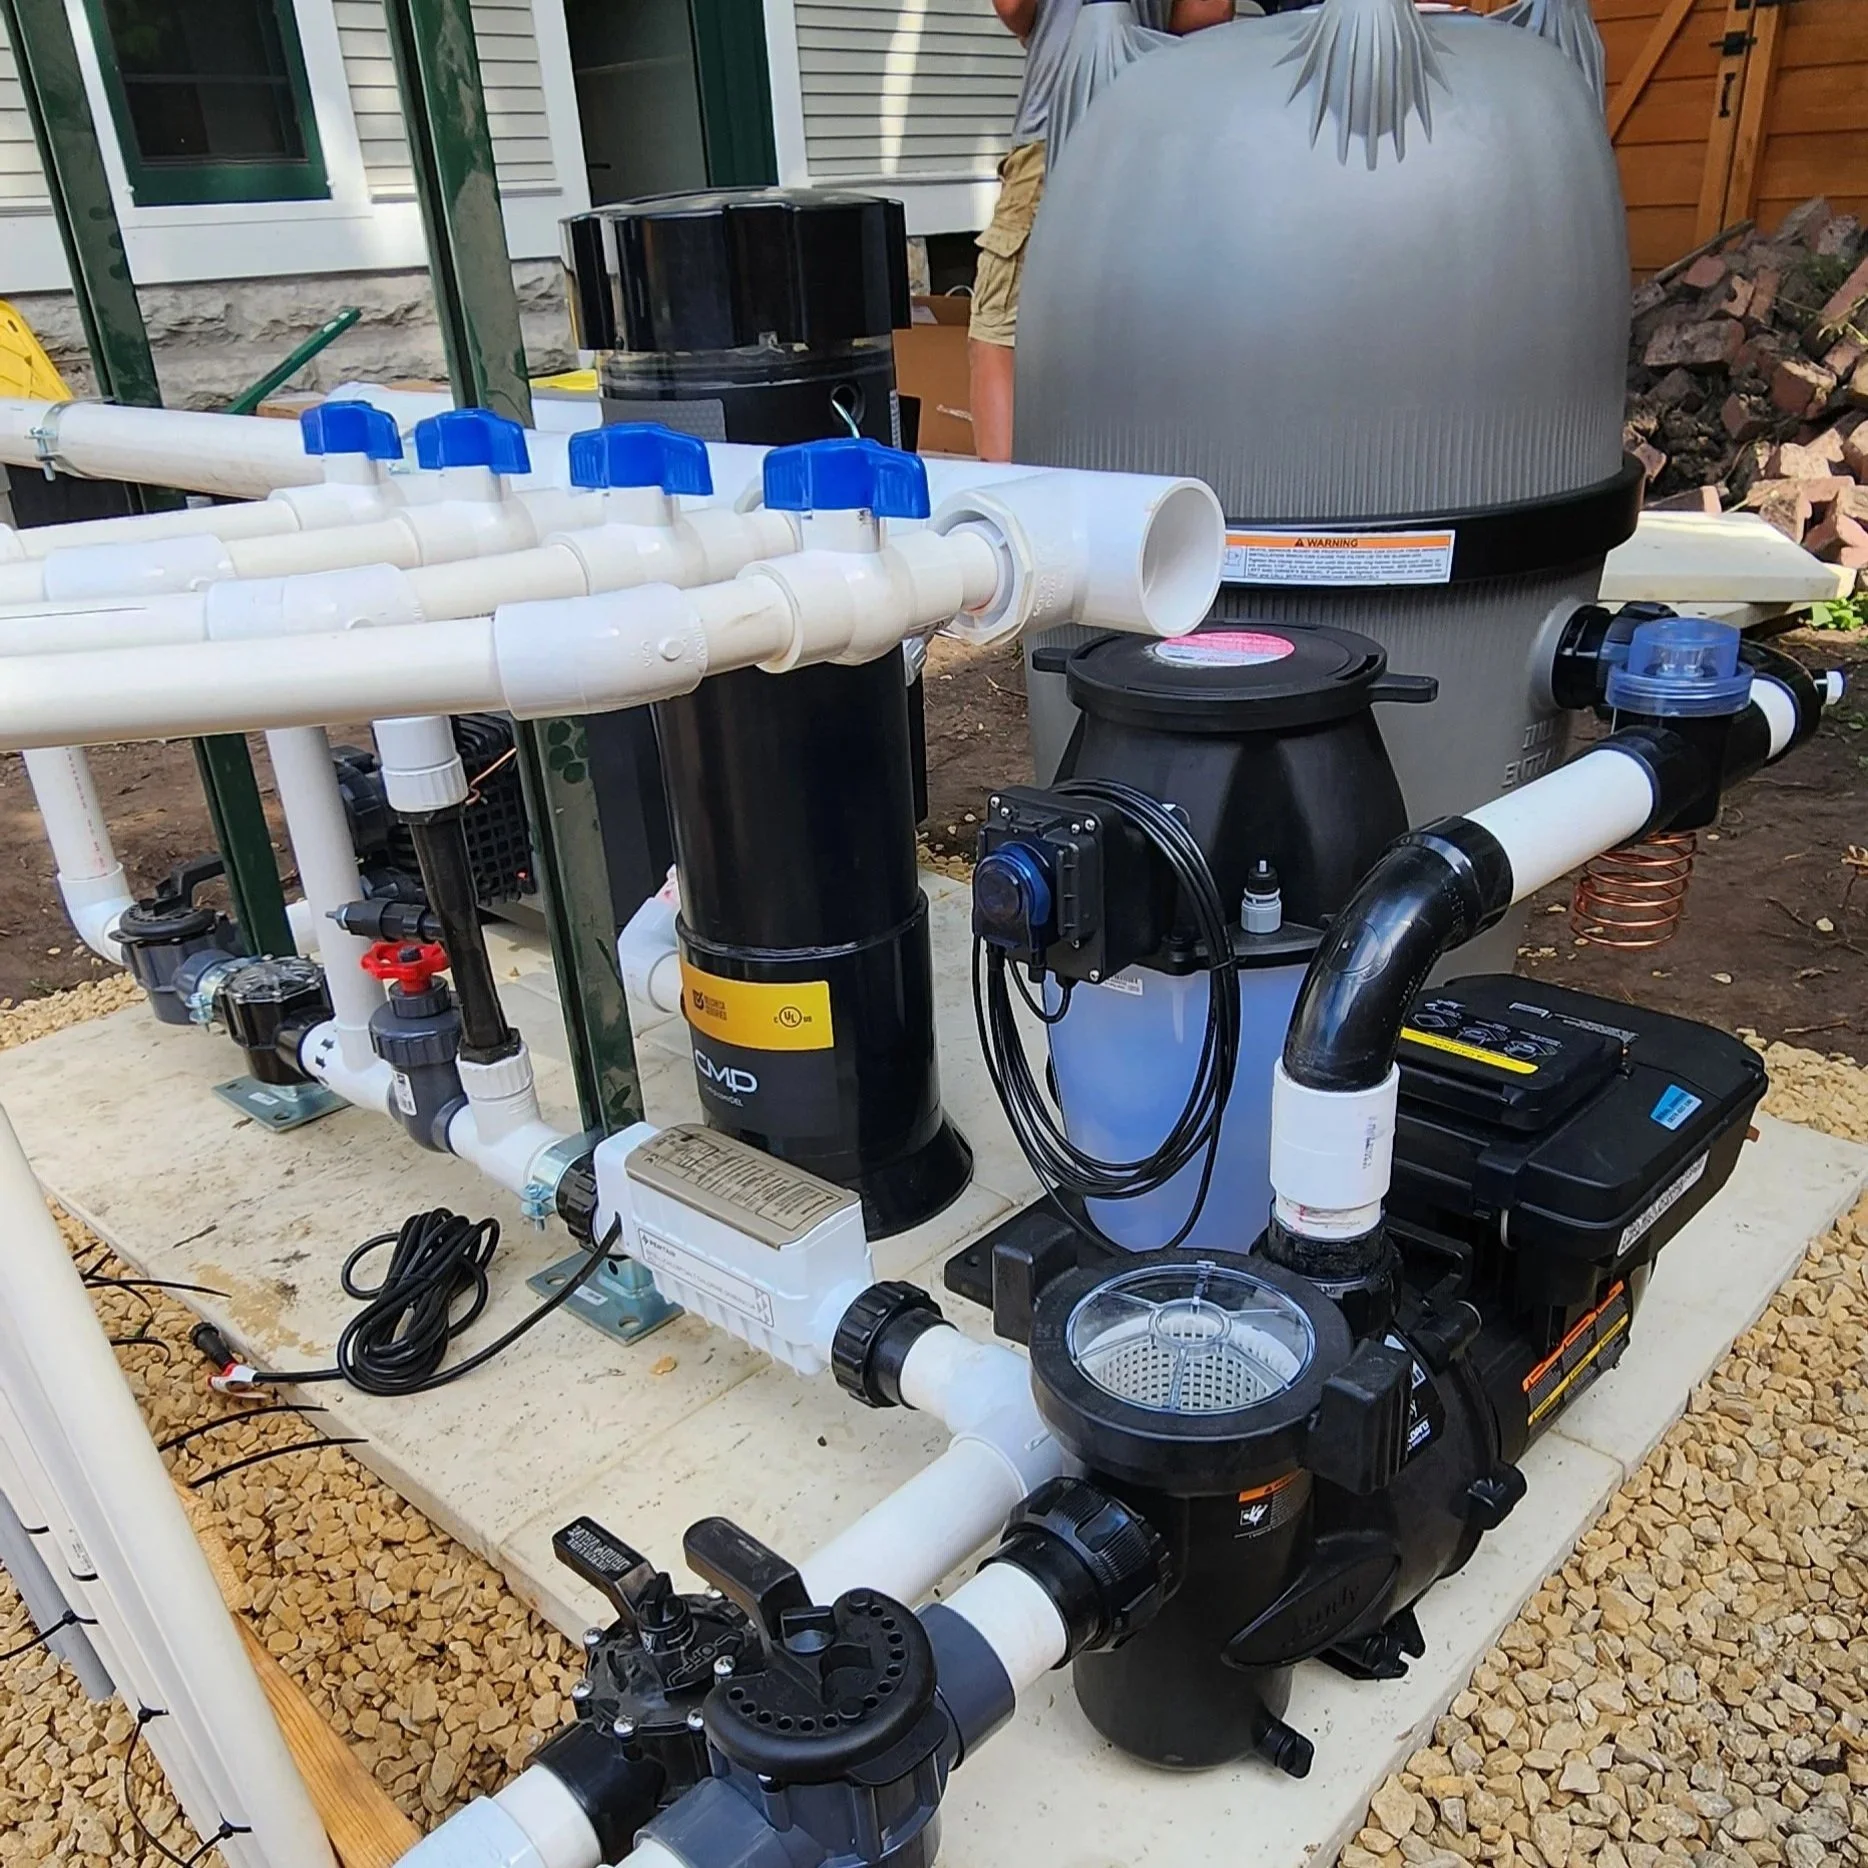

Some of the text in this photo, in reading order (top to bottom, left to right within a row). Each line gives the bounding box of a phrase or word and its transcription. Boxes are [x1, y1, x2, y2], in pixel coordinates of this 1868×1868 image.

[1306, 538, 1358, 548] WARNING
[784, 1011, 797, 1024] UL
[694, 1049, 758, 1093] CMP
[566, 1524, 630, 1571] JANDY VALVE
